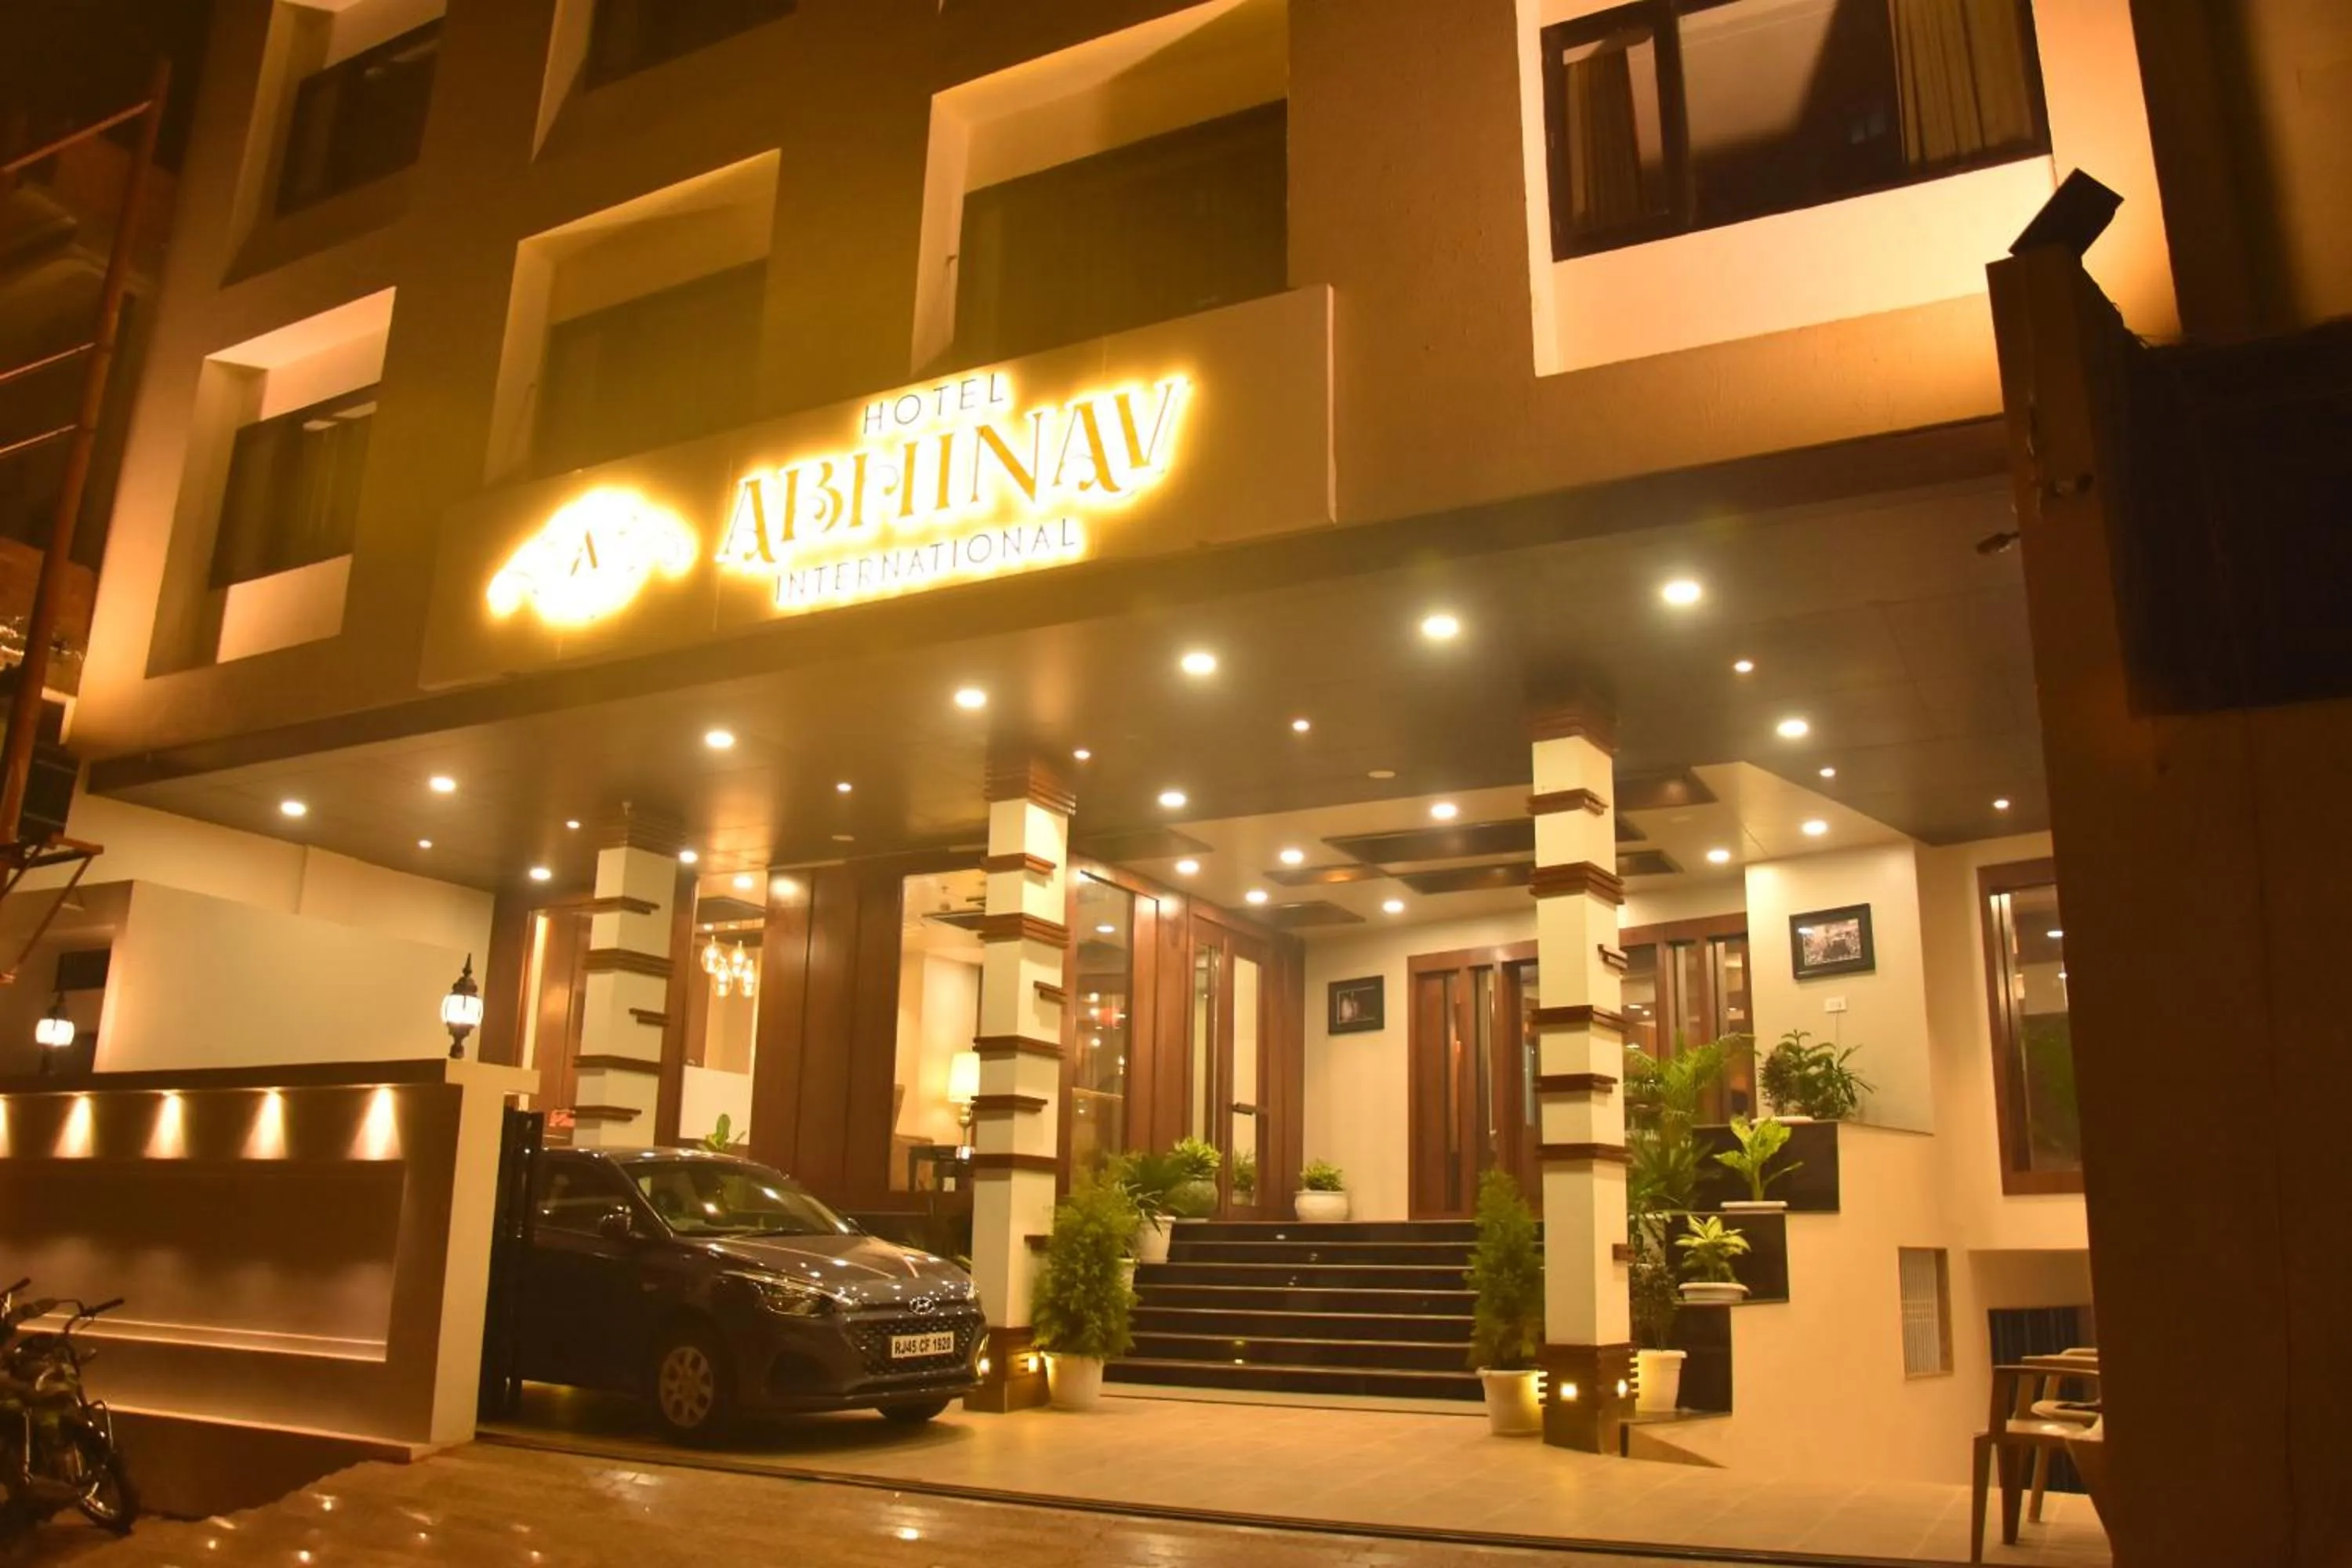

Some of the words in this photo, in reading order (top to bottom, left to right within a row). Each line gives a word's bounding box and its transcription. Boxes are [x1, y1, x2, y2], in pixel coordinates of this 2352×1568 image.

[863, 372, 1004, 434] HOTEL
[720, 380, 1187, 563] ABHINAV
[775, 517, 1076, 603] INTERNATIONAL
